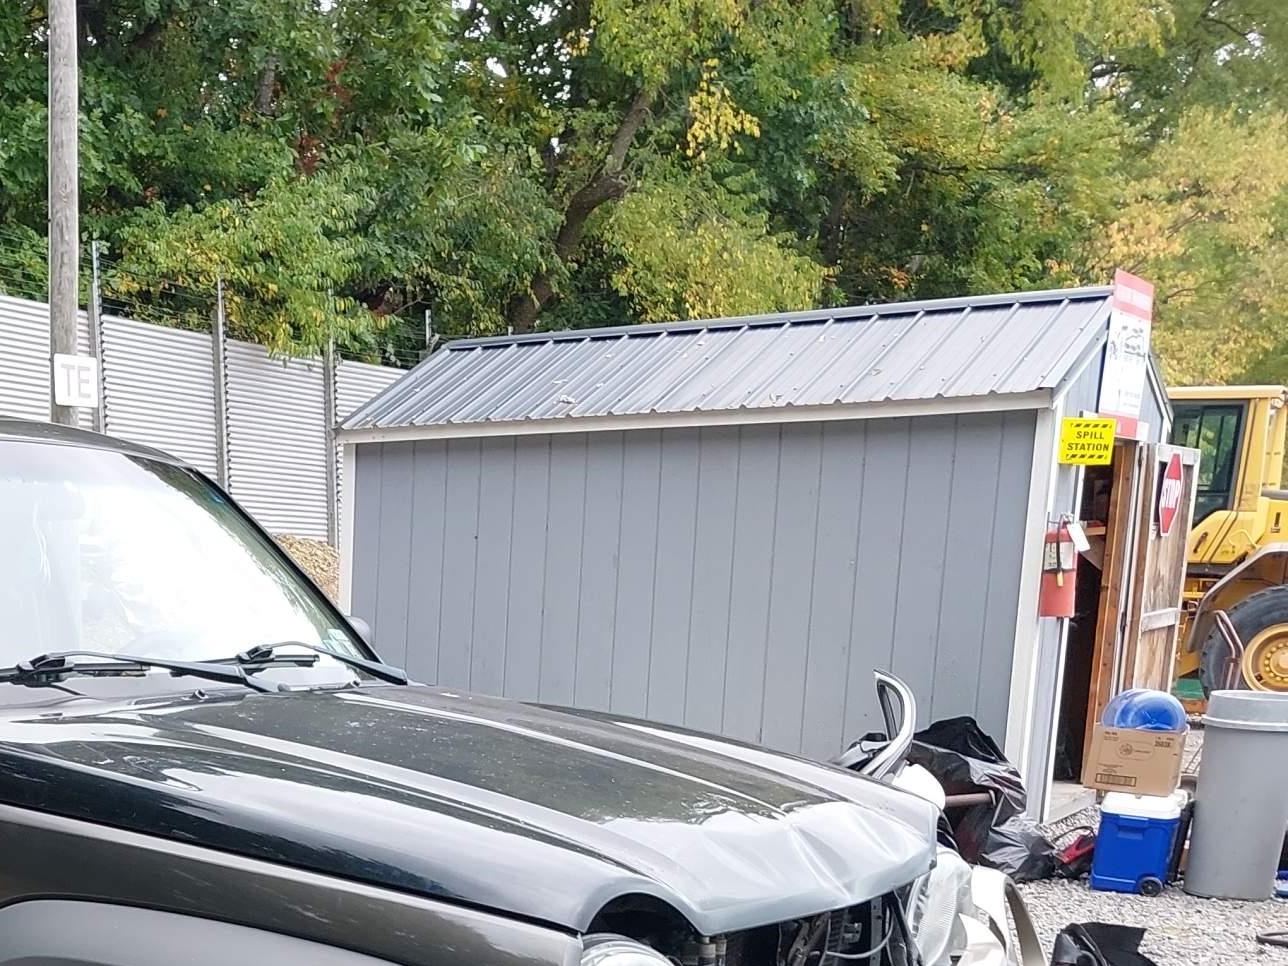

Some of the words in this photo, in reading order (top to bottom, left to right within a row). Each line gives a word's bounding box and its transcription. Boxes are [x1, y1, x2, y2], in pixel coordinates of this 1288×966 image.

[60, 363, 91, 398] TE
[1076, 430, 1105, 440] SPILL
[1067, 442, 1110, 451] STATION
[1161, 478, 1180, 508] STOP
